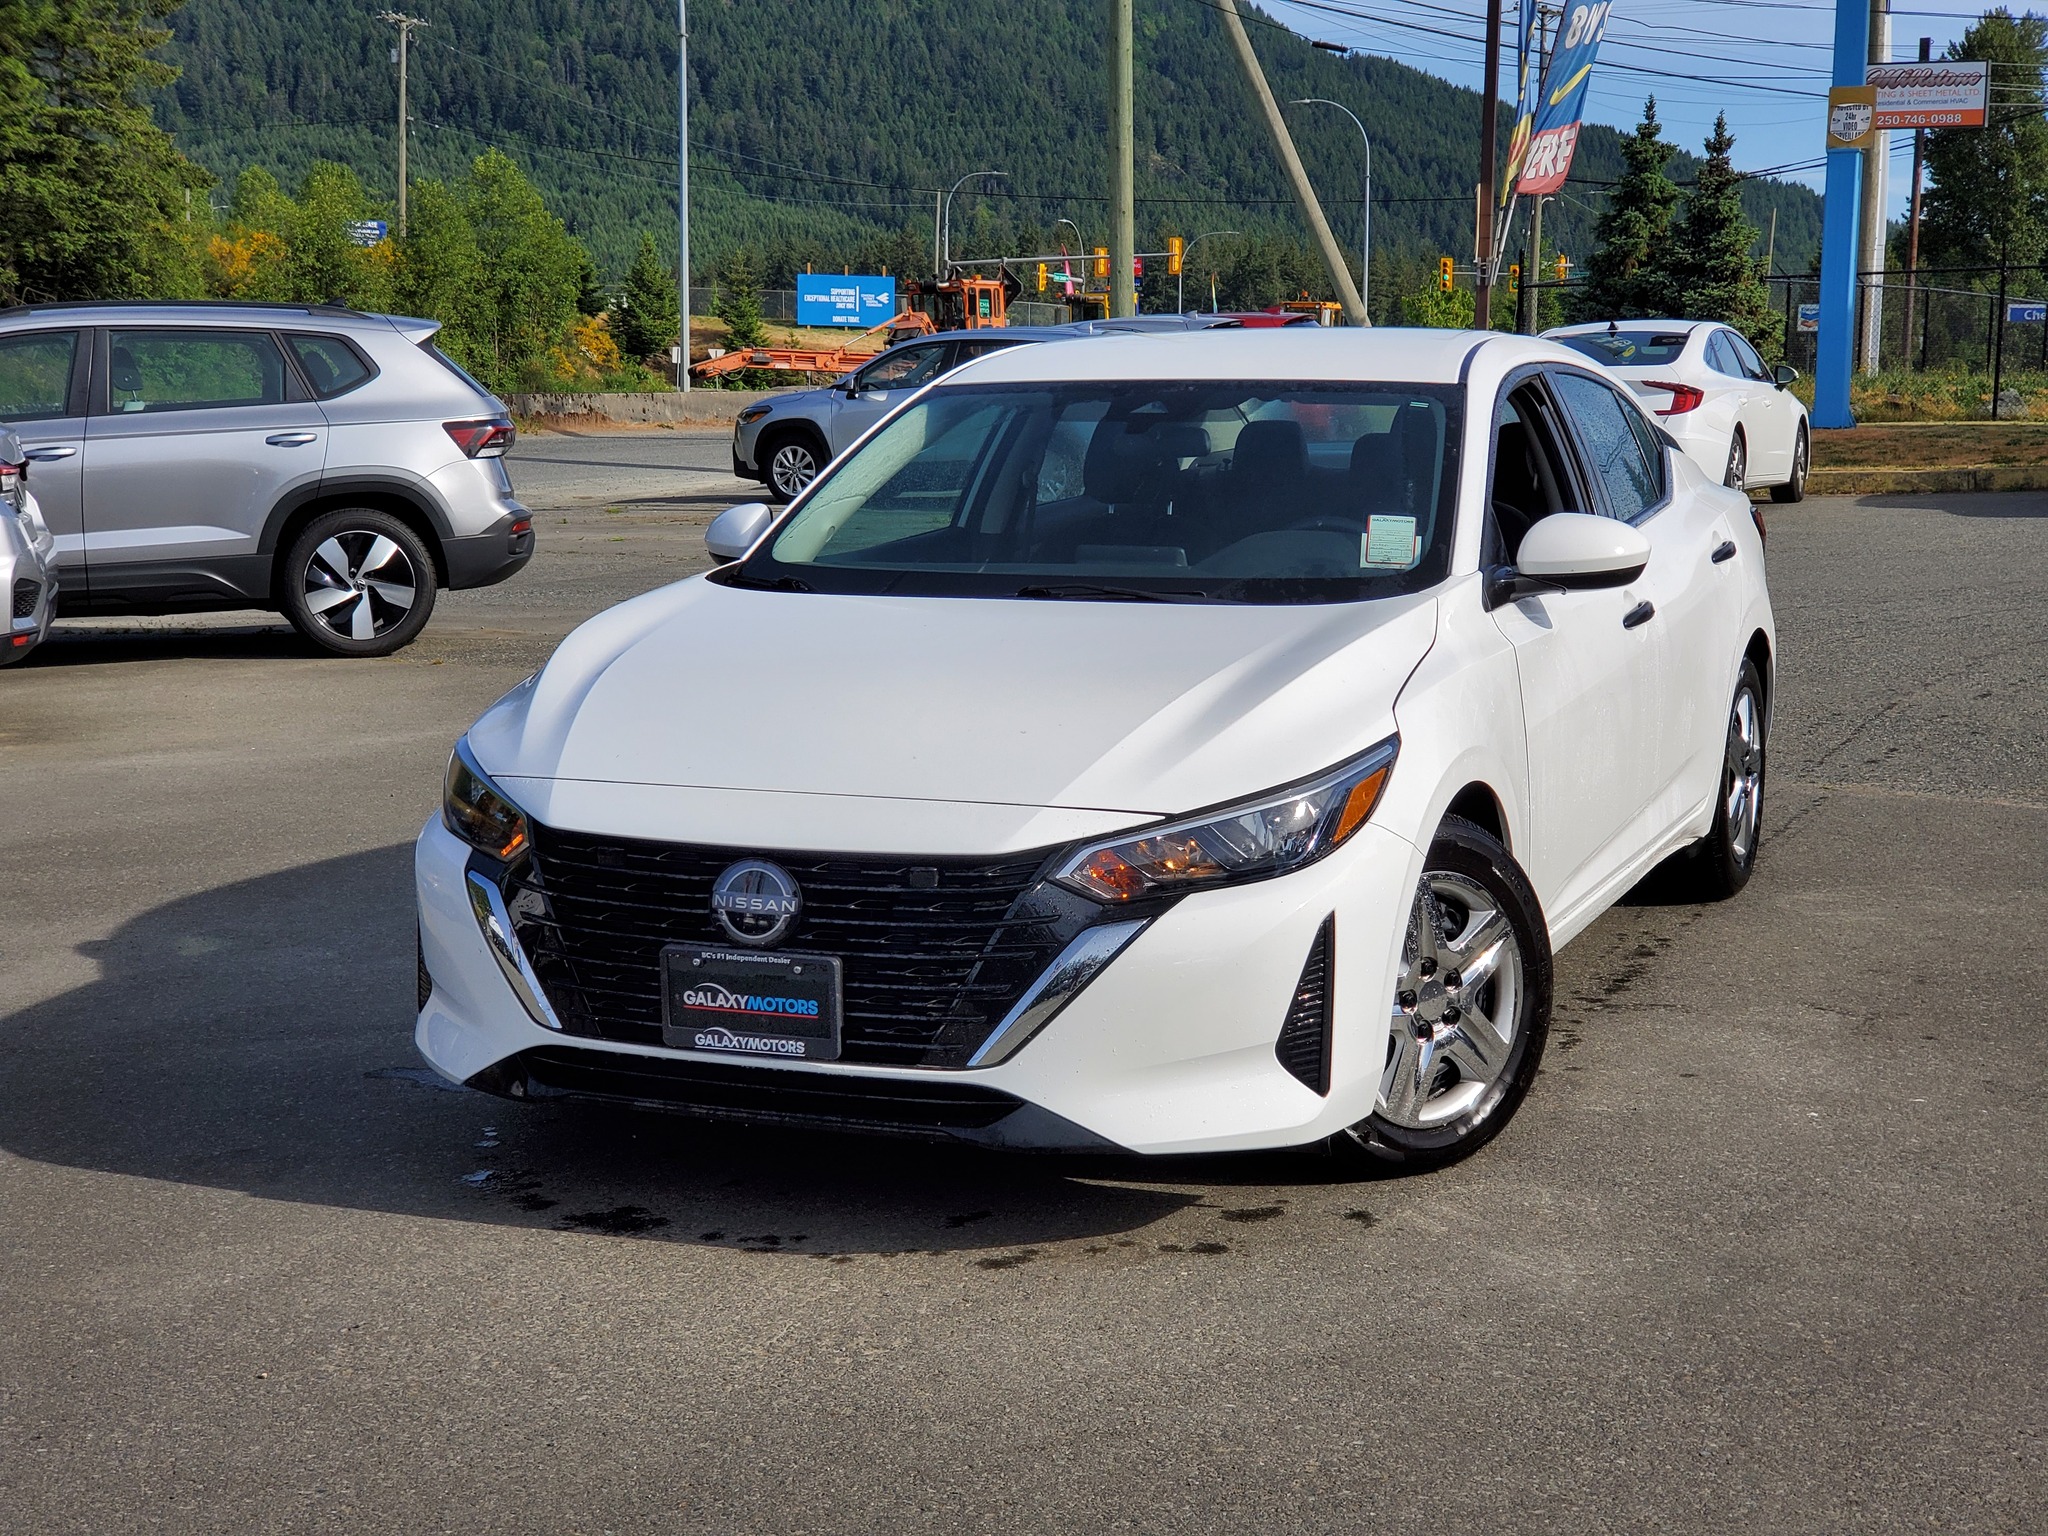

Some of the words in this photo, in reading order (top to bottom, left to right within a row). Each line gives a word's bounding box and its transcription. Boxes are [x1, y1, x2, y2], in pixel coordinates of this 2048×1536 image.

[1866, 67, 1982, 89] Millstone
[1908, 89, 1933, 97] SHEET
[1936, 89, 1961, 97] METAL
[1877, 99, 1906, 107] esidential
[1913, 98, 1948, 106] Commercial
[1845, 112, 1857, 121] 24hr
[1877, 113, 1962, 125] 250-746-0988
[1843, 121, 1858, 131] VIDEO
[714, 894, 797, 912] NISSAN
[726, 953, 767, 963] Independent
[768, 956, 791, 964] Dealer
